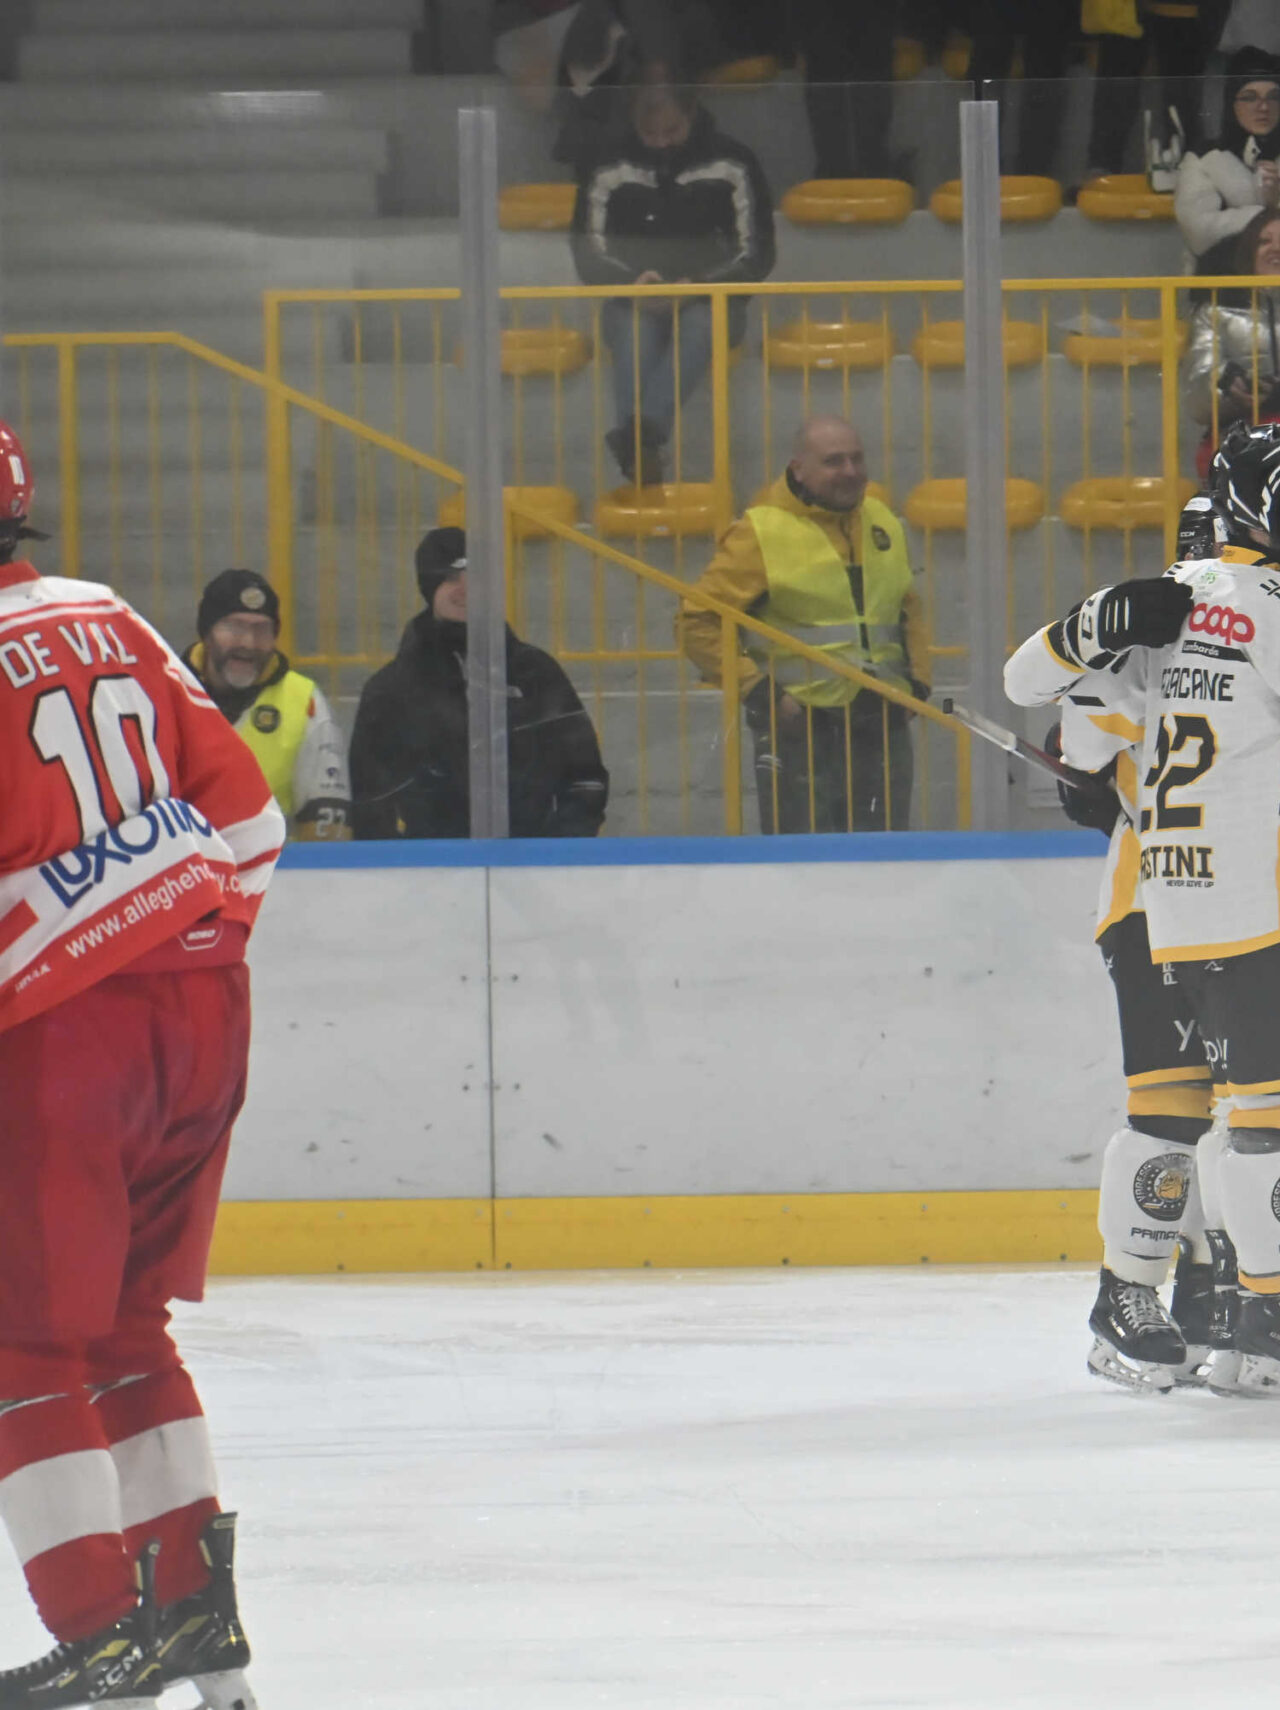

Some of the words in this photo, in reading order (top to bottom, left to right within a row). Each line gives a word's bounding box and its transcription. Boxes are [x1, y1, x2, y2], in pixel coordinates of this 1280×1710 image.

[0, 631, 61, 689] DE
[57, 621, 138, 667] VAL
[1188, 601, 1256, 647] coop
[28, 673, 173, 844] 10
